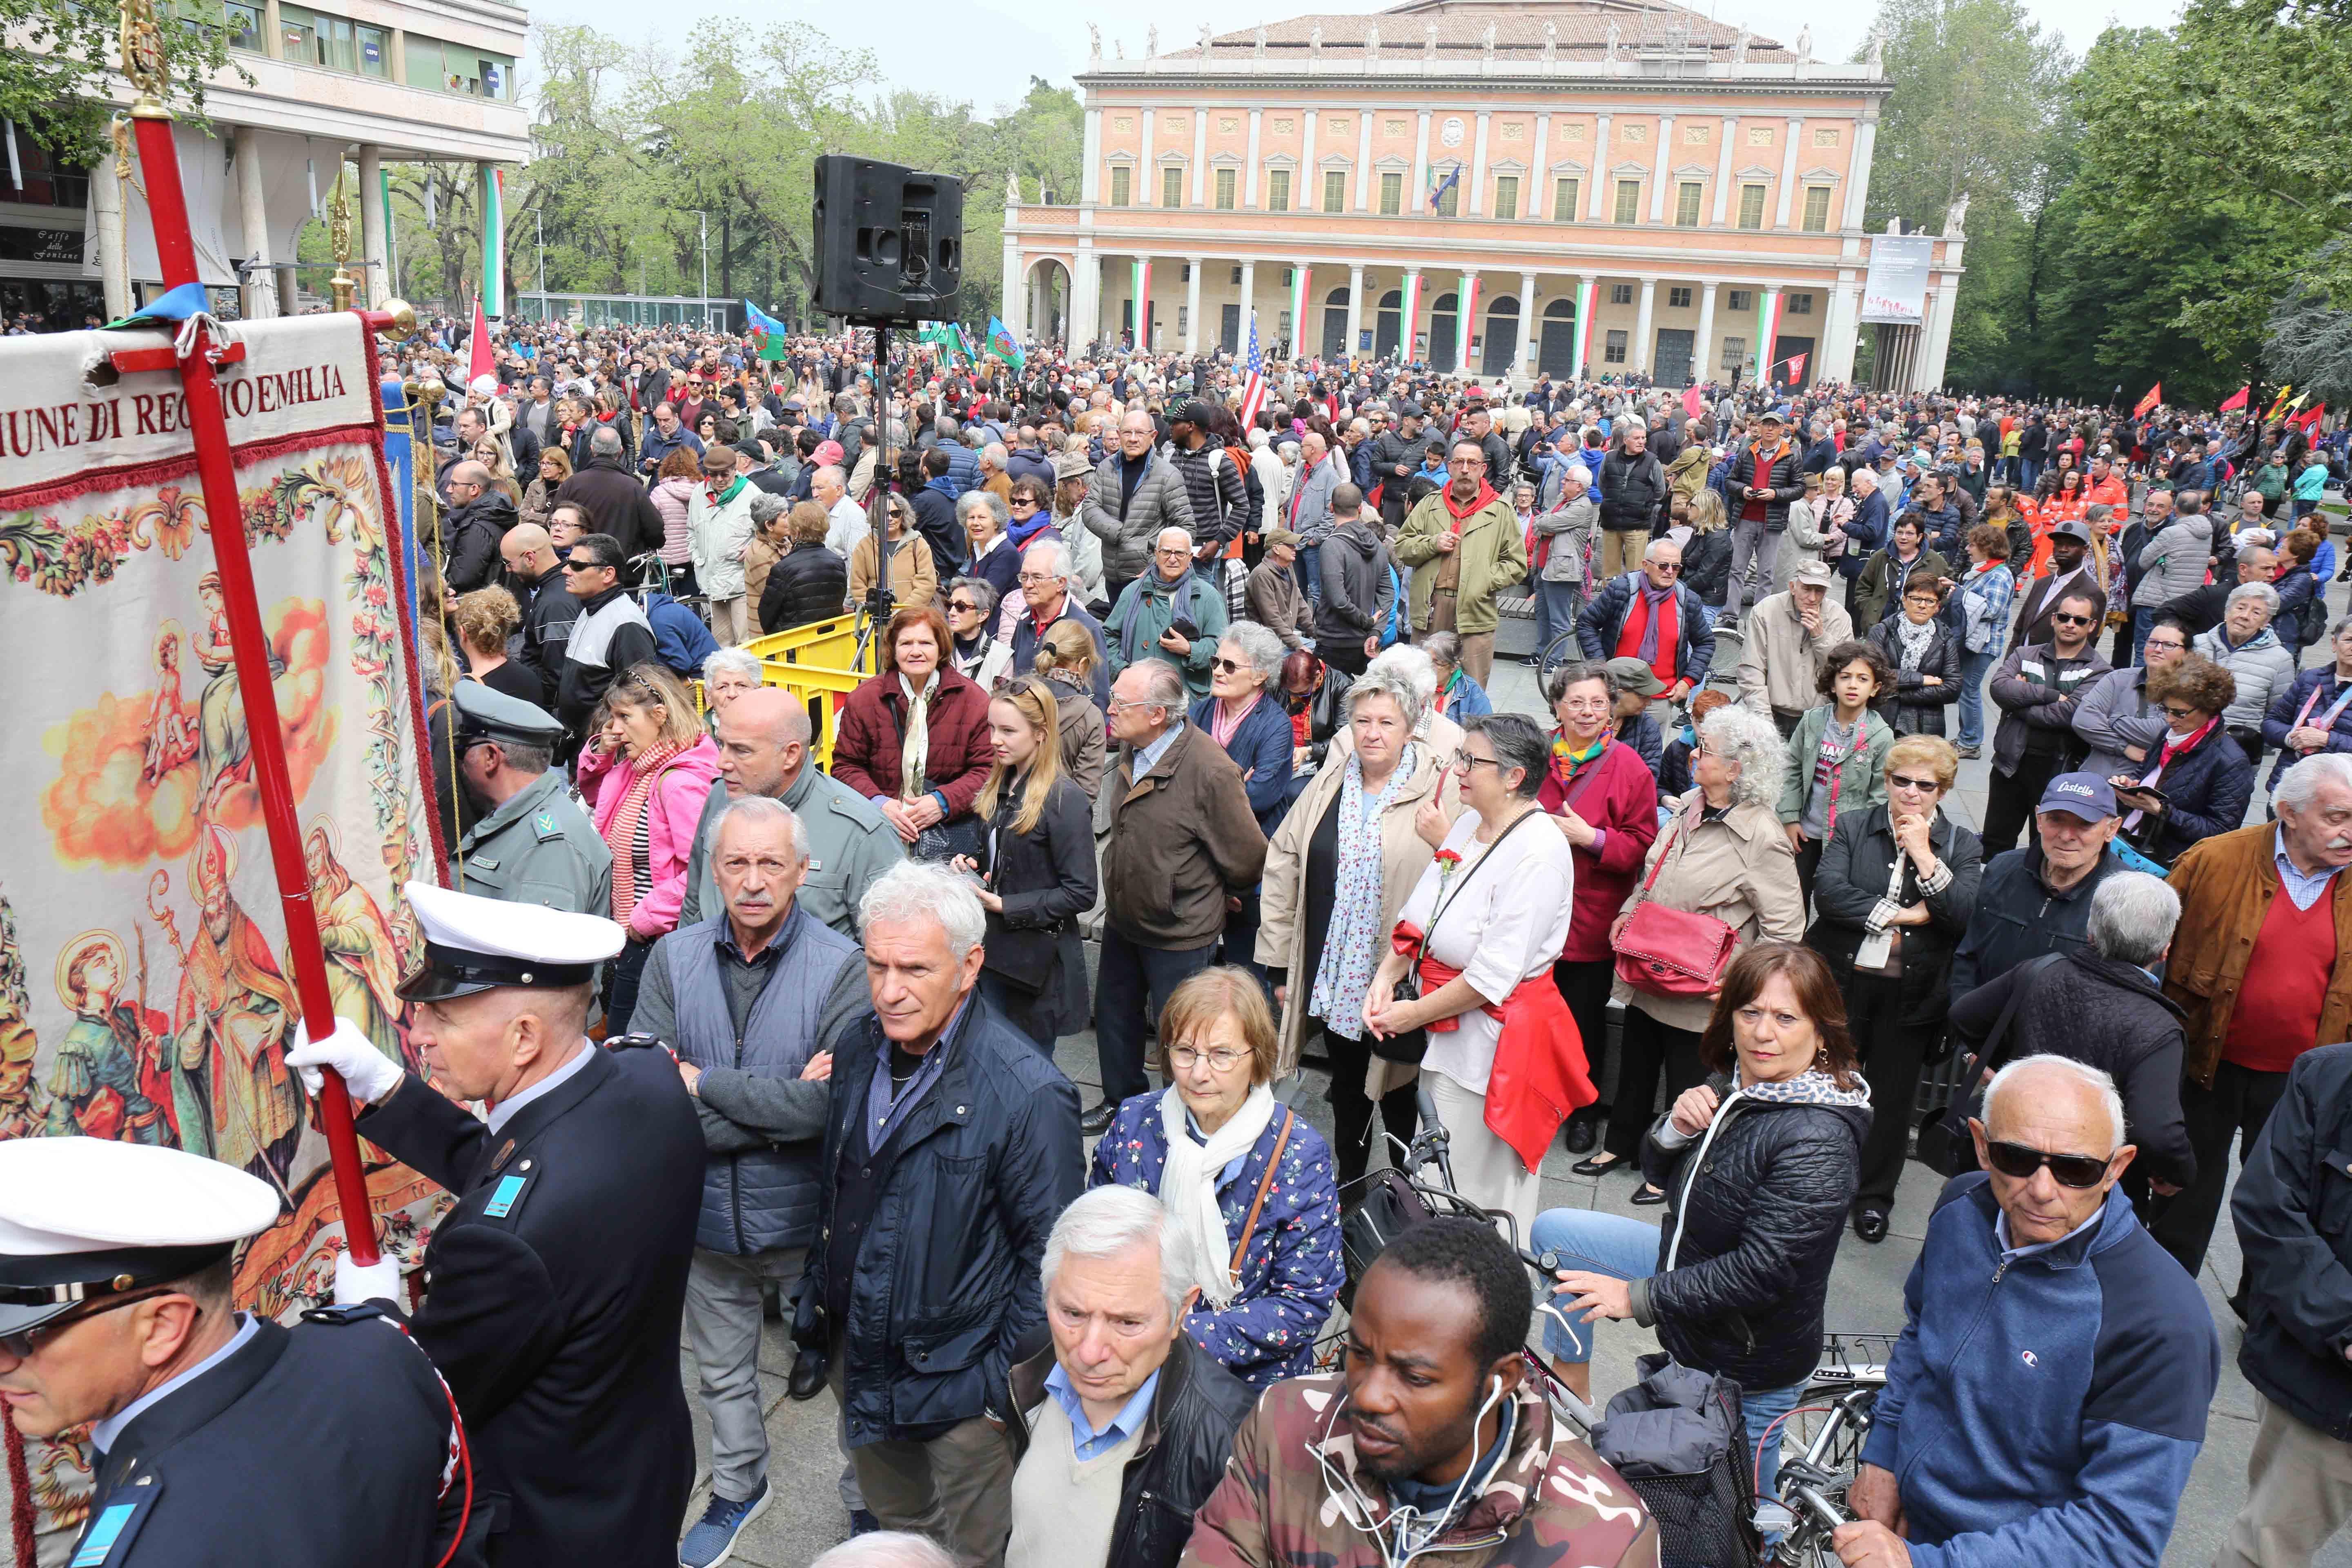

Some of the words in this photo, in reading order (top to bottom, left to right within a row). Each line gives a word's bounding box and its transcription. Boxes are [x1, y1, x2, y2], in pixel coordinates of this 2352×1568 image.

[38, 231, 69, 242] Caffè
[47, 242, 62, 250] delle
[85, 398, 123, 442] DI
[256, 364, 347, 413] EMILIA
[2057, 781, 2094, 796] Castello
